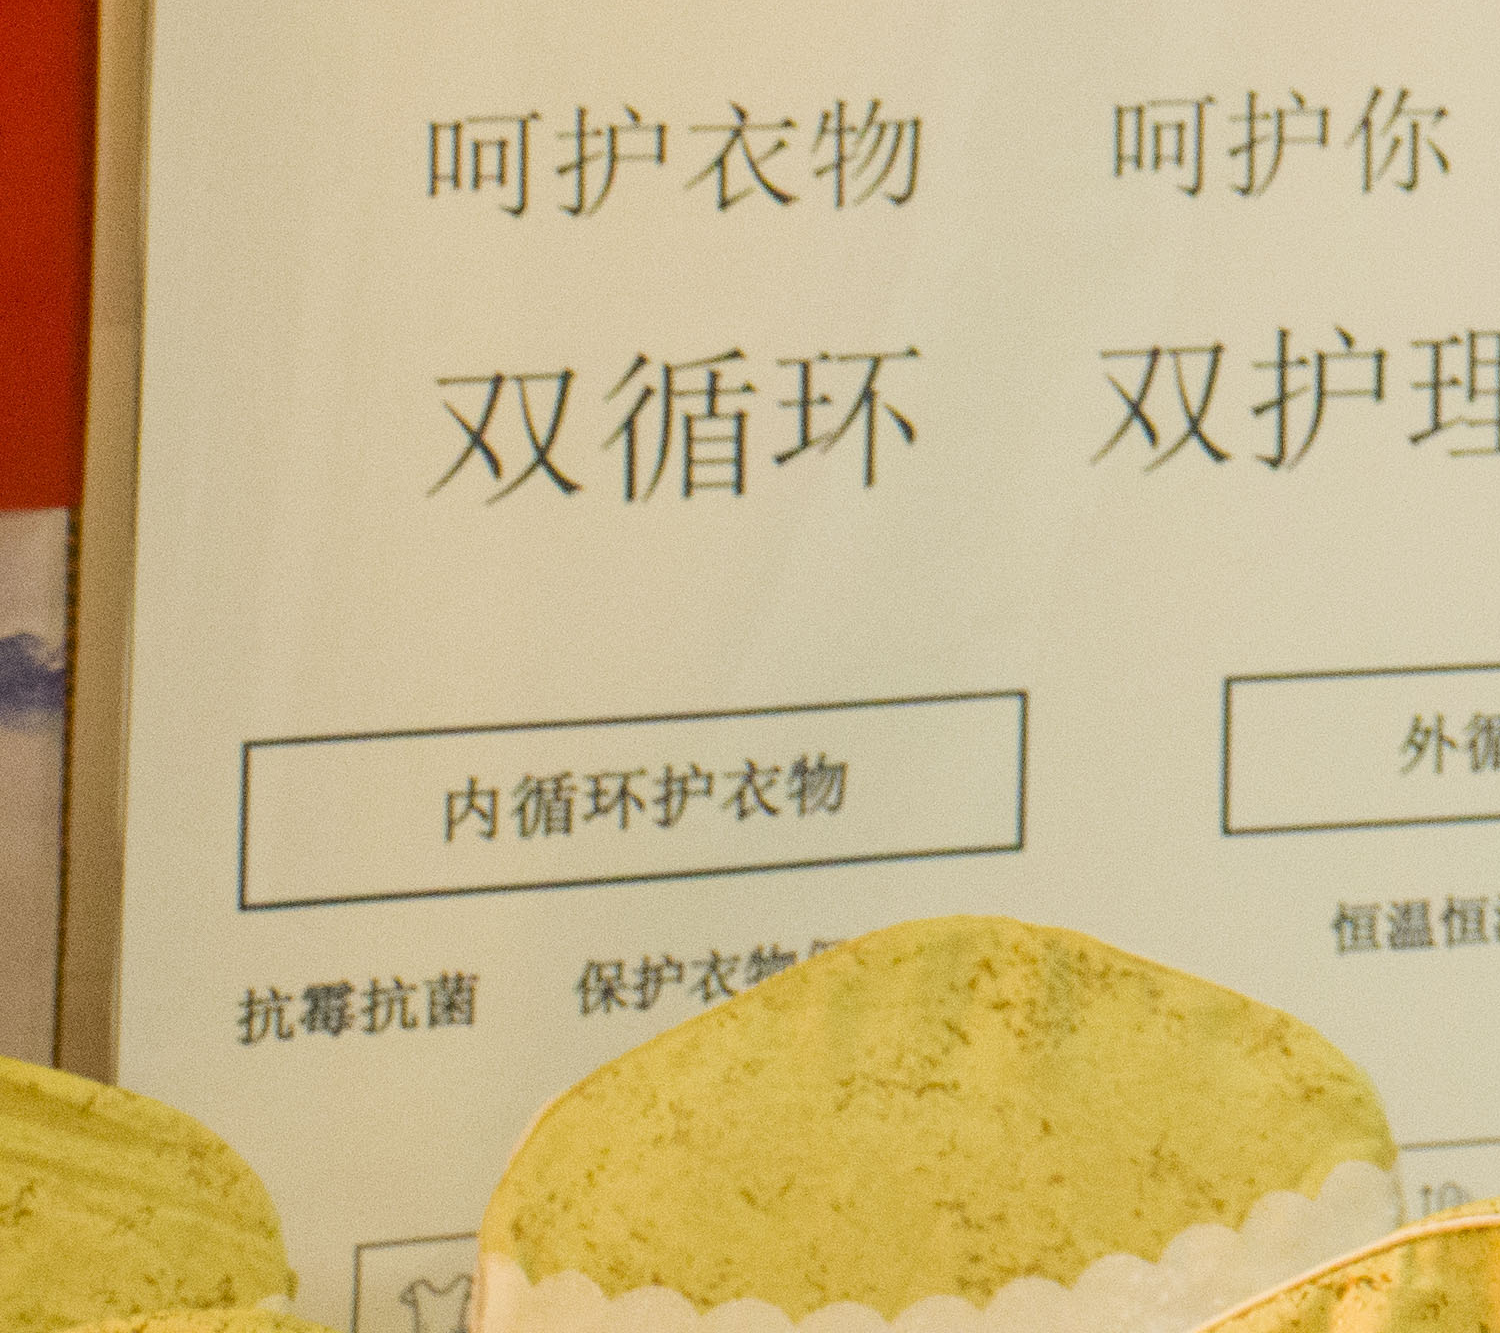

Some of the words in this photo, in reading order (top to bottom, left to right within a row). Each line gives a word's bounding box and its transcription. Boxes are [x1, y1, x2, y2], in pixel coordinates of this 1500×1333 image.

[426, 98, 924, 219] 呵护衣物
[1111, 86, 1452, 199] 呵护你
[425, 346, 921, 507] 双循环
[443, 751, 850, 844] 内循环护衣物
[237, 971, 480, 1047] 抗霉抗菌
[574, 938, 850, 1018] 保护衣物
